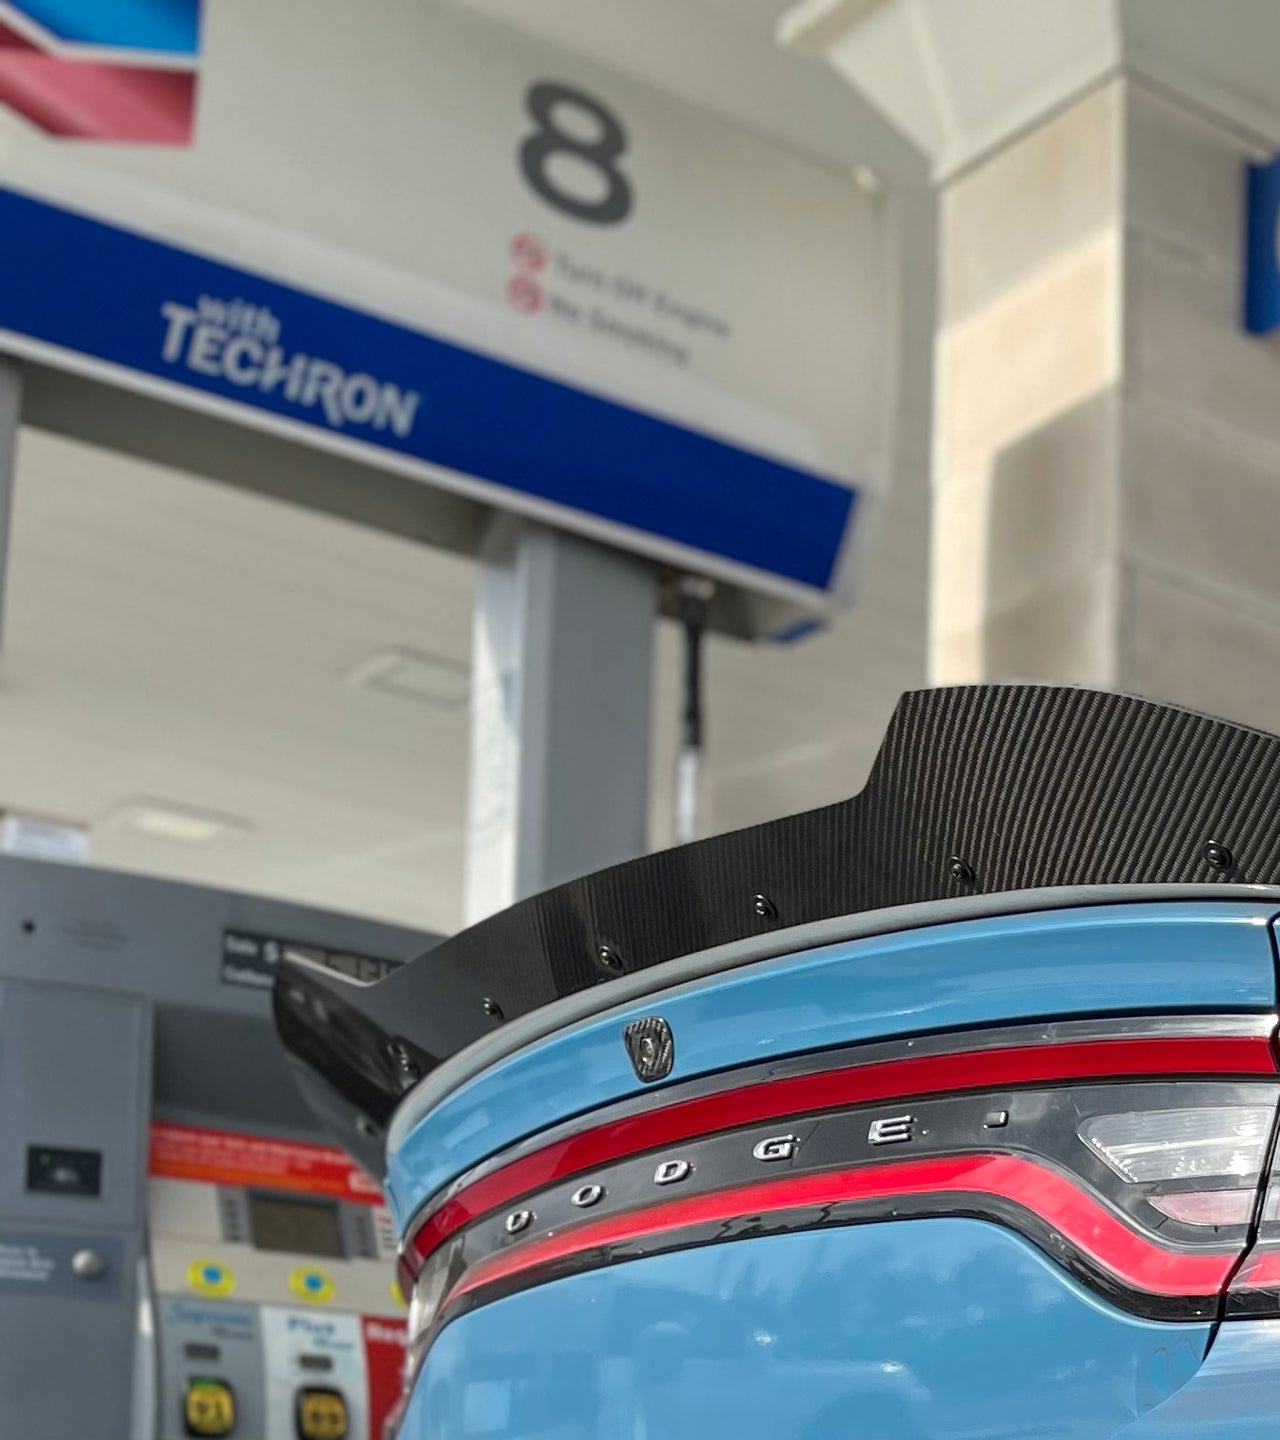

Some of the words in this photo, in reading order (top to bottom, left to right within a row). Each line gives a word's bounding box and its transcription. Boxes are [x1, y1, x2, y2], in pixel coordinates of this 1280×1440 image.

[517, 78, 635, 228] 8
[162, 301, 420, 437] TECHRON
[198, 295, 281, 344] with
[505, 1115, 916, 1232] DODGE
